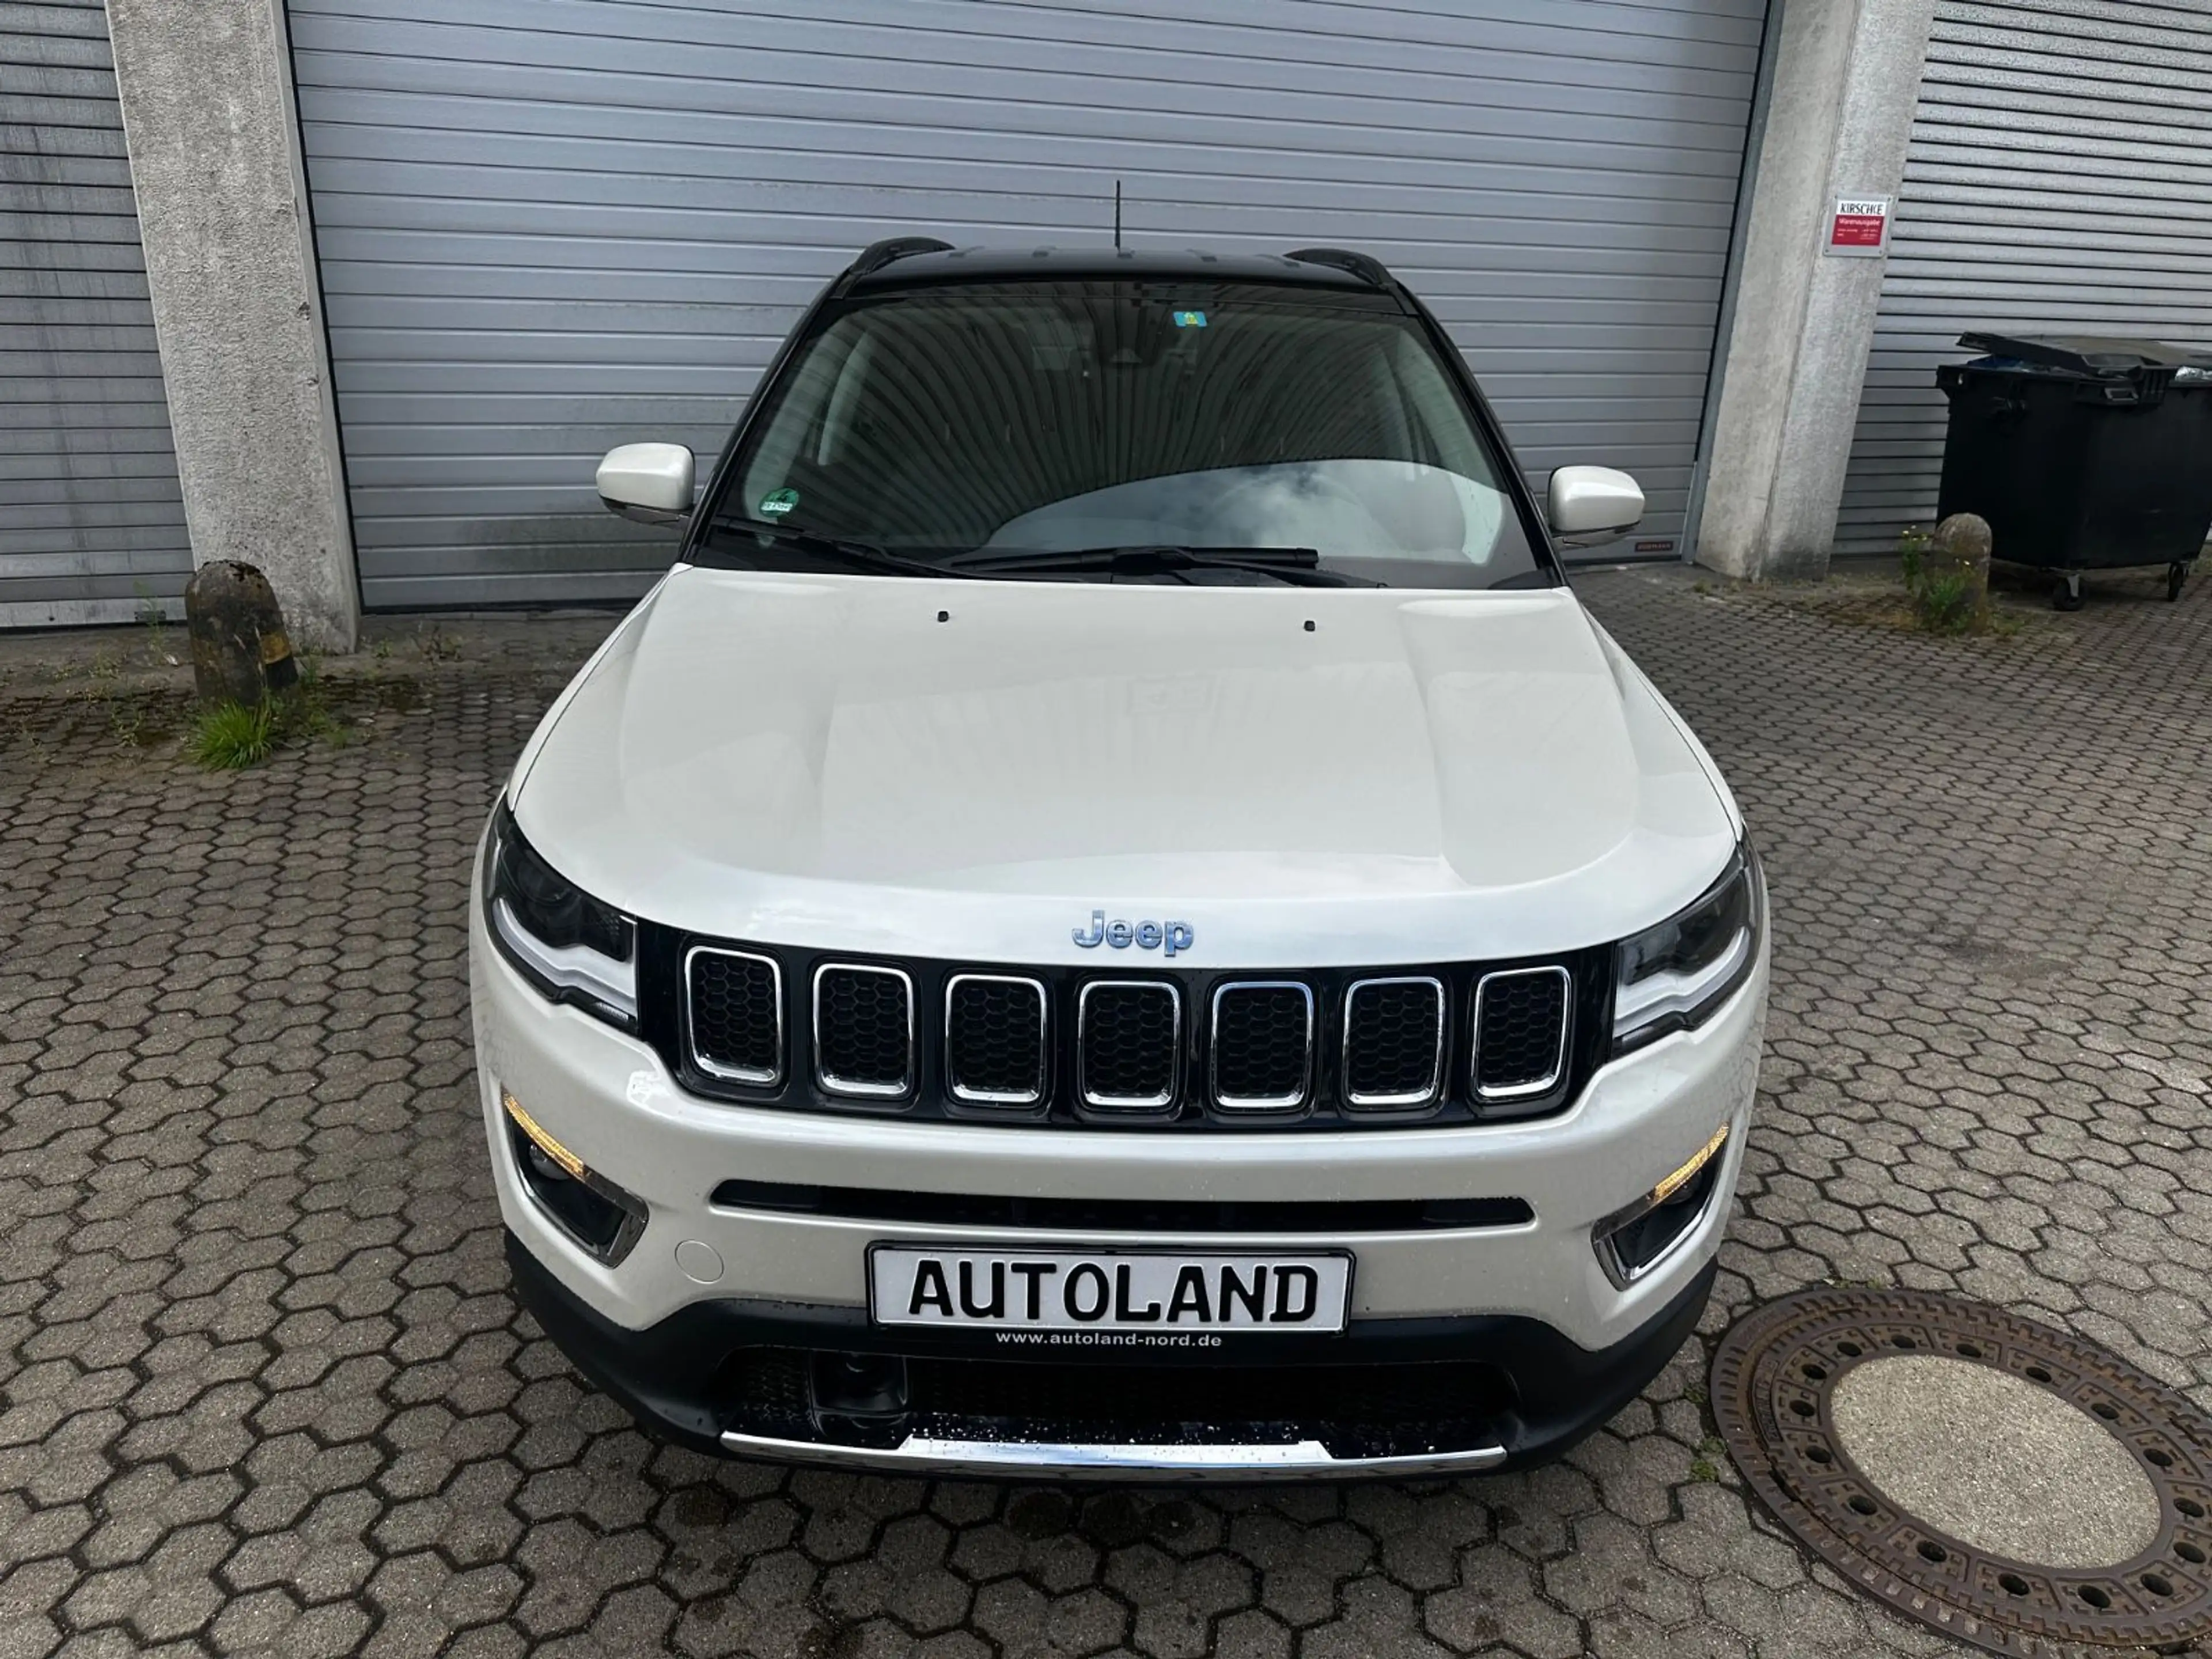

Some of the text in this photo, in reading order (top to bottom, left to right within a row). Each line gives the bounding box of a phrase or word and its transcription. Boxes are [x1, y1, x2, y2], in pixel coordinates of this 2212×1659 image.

[1840, 203, 1883, 214] KIRSCHKE
[1072, 910, 1194, 957] Jeep
[908, 1260, 1318, 1322] AUTOLAND
[996, 1332, 1222, 1346] www.autoland-nord.de
